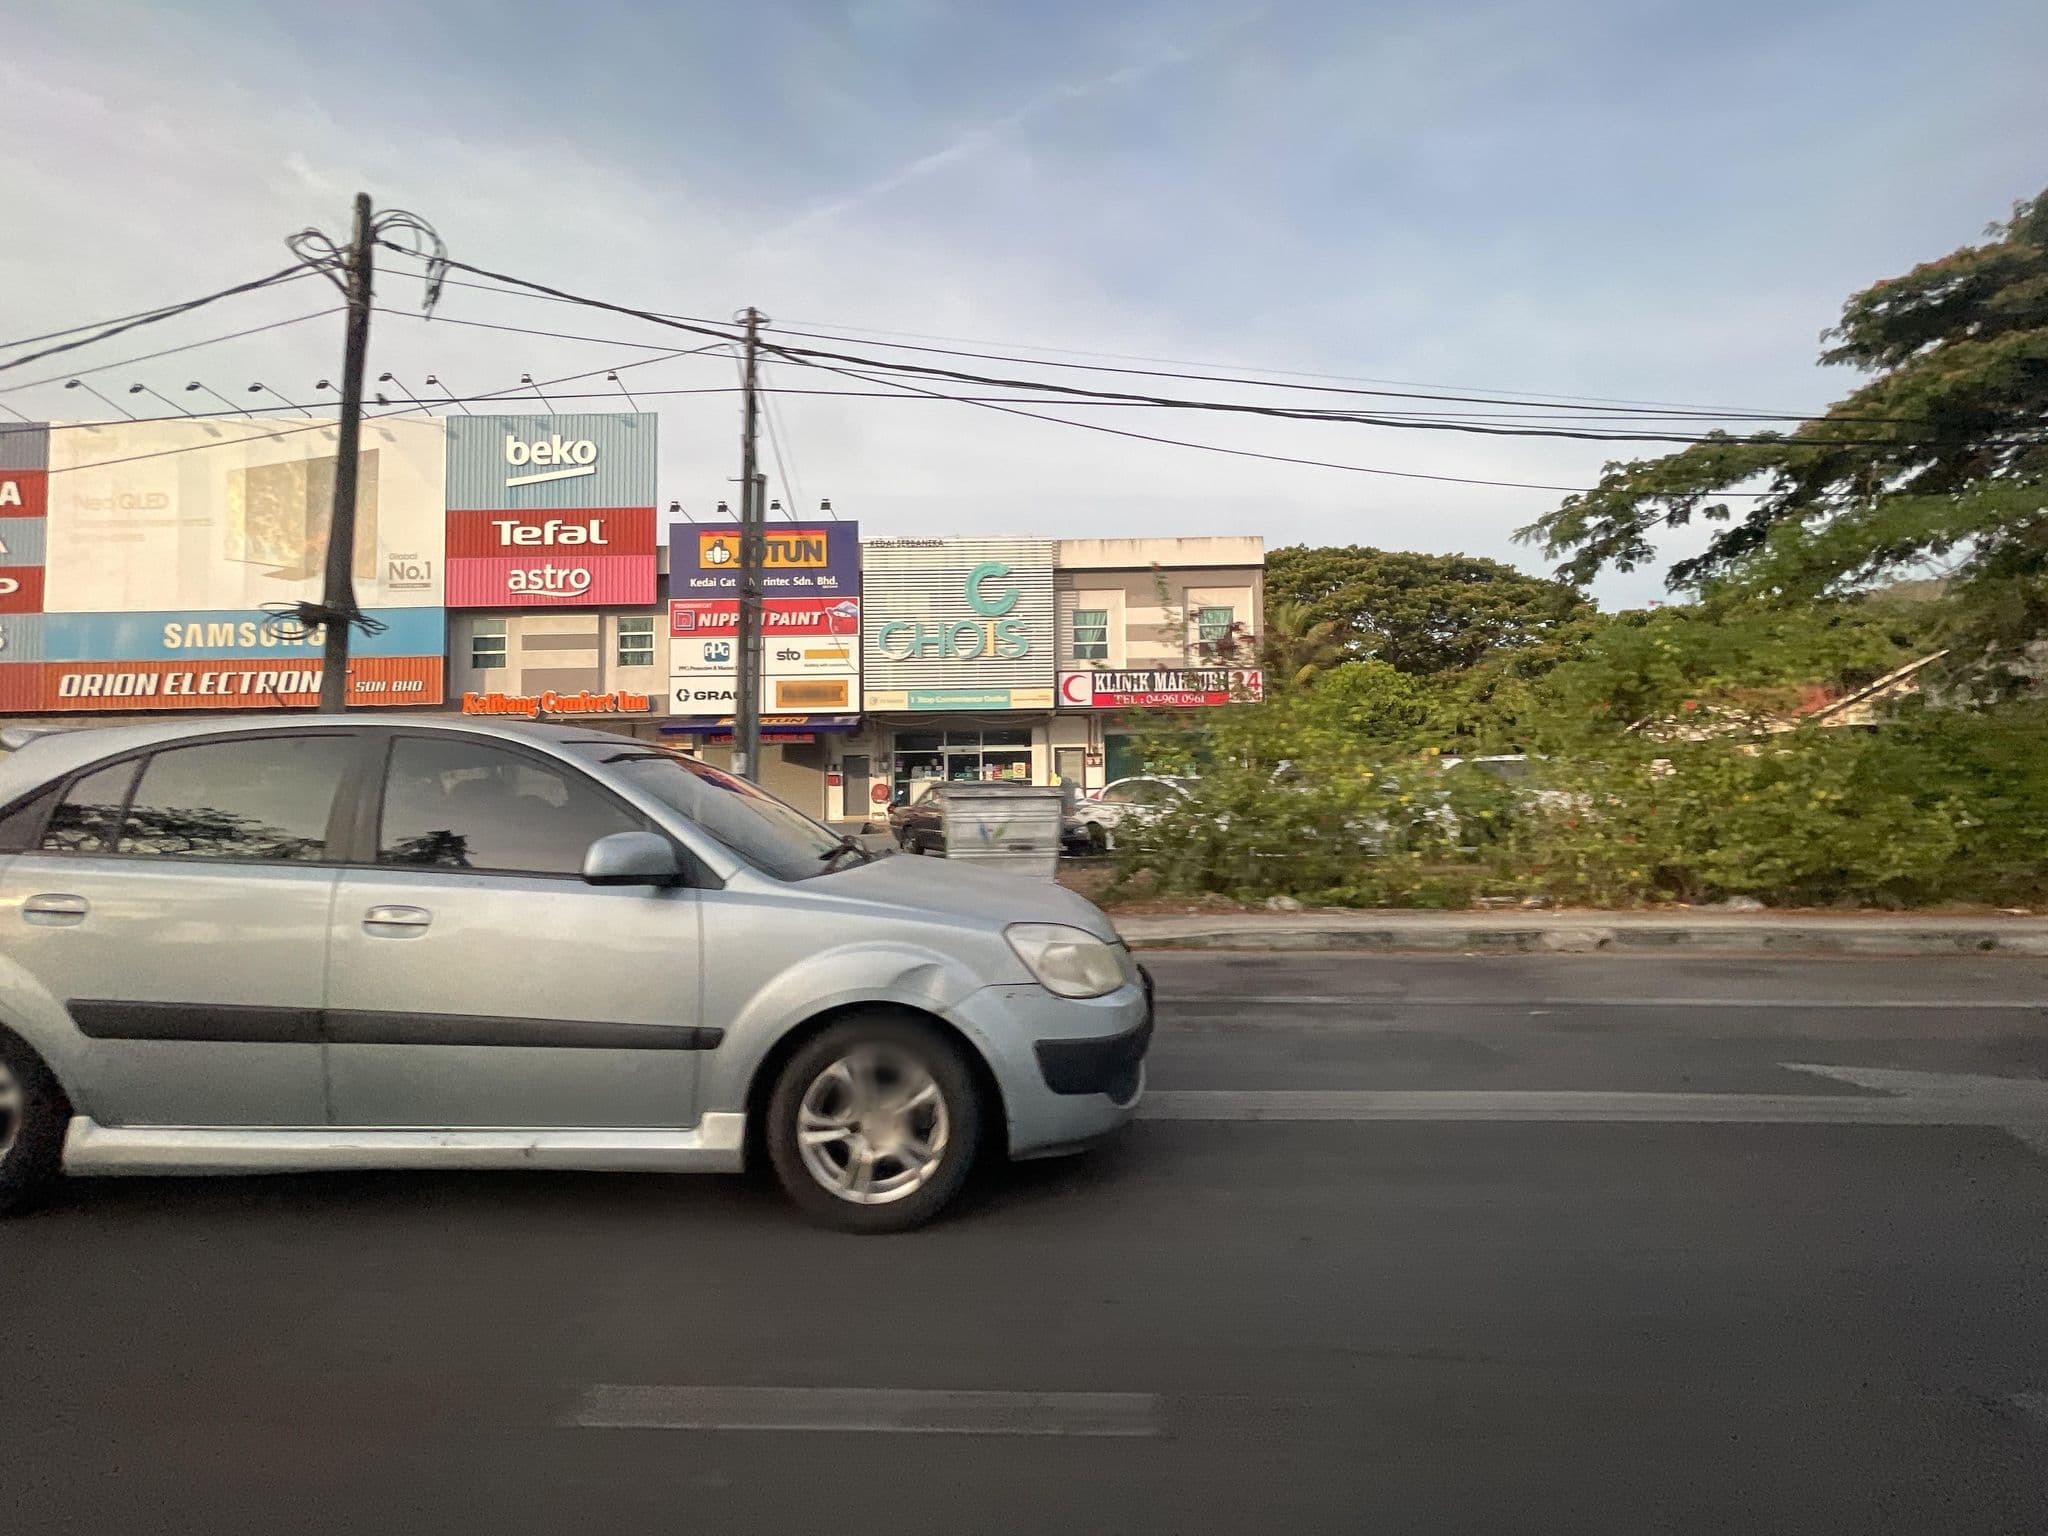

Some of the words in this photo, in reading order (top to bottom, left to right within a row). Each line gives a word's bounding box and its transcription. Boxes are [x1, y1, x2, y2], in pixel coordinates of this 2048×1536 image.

[506, 434, 597, 466] beko
[491, 519, 609, 546] Tefal
[389, 561, 431, 580] No.1
[507, 564, 591, 590] astro
[690, 577, 717, 588] Kedai
[720, 577, 737, 588] Cat
[793, 576, 814, 586] Sdn.
[817, 575, 839, 587] Bhd.
[698, 612, 765, 627] NIPP
[769, 611, 821, 626] PAINT
[163, 622, 327, 649] SAMSUNG
[878, 619, 1030, 661] CHOIS
[704, 641, 730, 659] PPG
[776, 648, 801, 661] sto
[58, 672, 160, 698] ORION
[1094, 672, 1150, 693] KLINIK
[541, 690, 616, 713] Comfort
[617, 690, 650, 712] Inn
[1114, 695, 1135, 705] TEL
[1182, 693, 1205, 704] 0961
